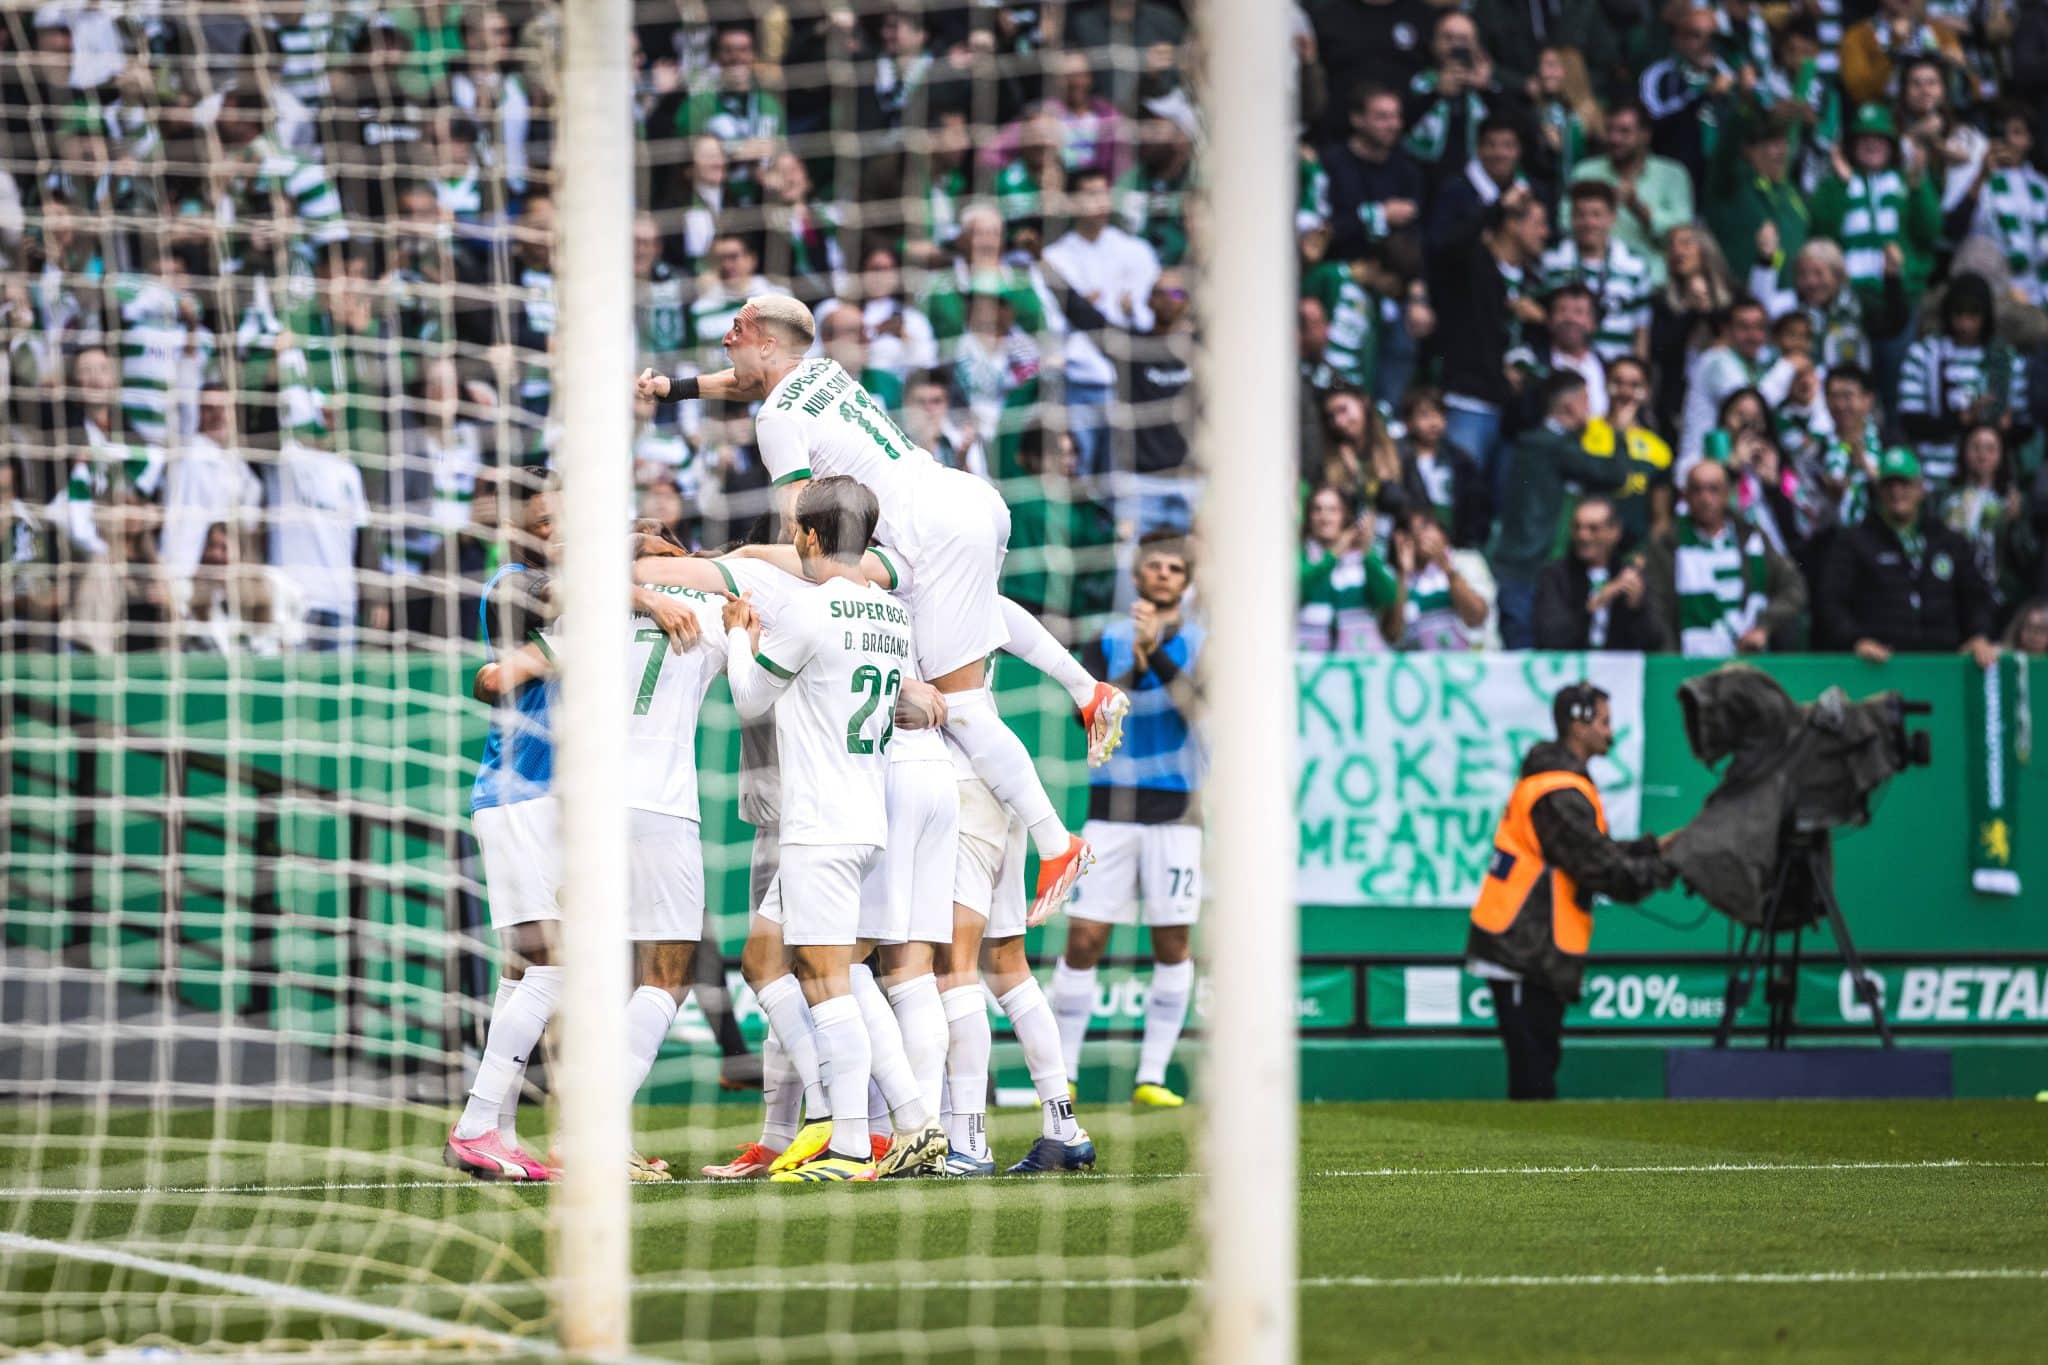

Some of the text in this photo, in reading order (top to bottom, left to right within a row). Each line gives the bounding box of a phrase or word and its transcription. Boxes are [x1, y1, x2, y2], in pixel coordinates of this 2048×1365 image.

[802, 370, 853, 418] NUNO SANT
[830, 600, 886, 622] SUPER
[844, 631, 856, 651] D.
[633, 628, 671, 715] 7
[1296, 652, 1489, 744] KTOR
[1167, 867, 1194, 898] 72
[1589, 974, 1688, 1020] 20%
